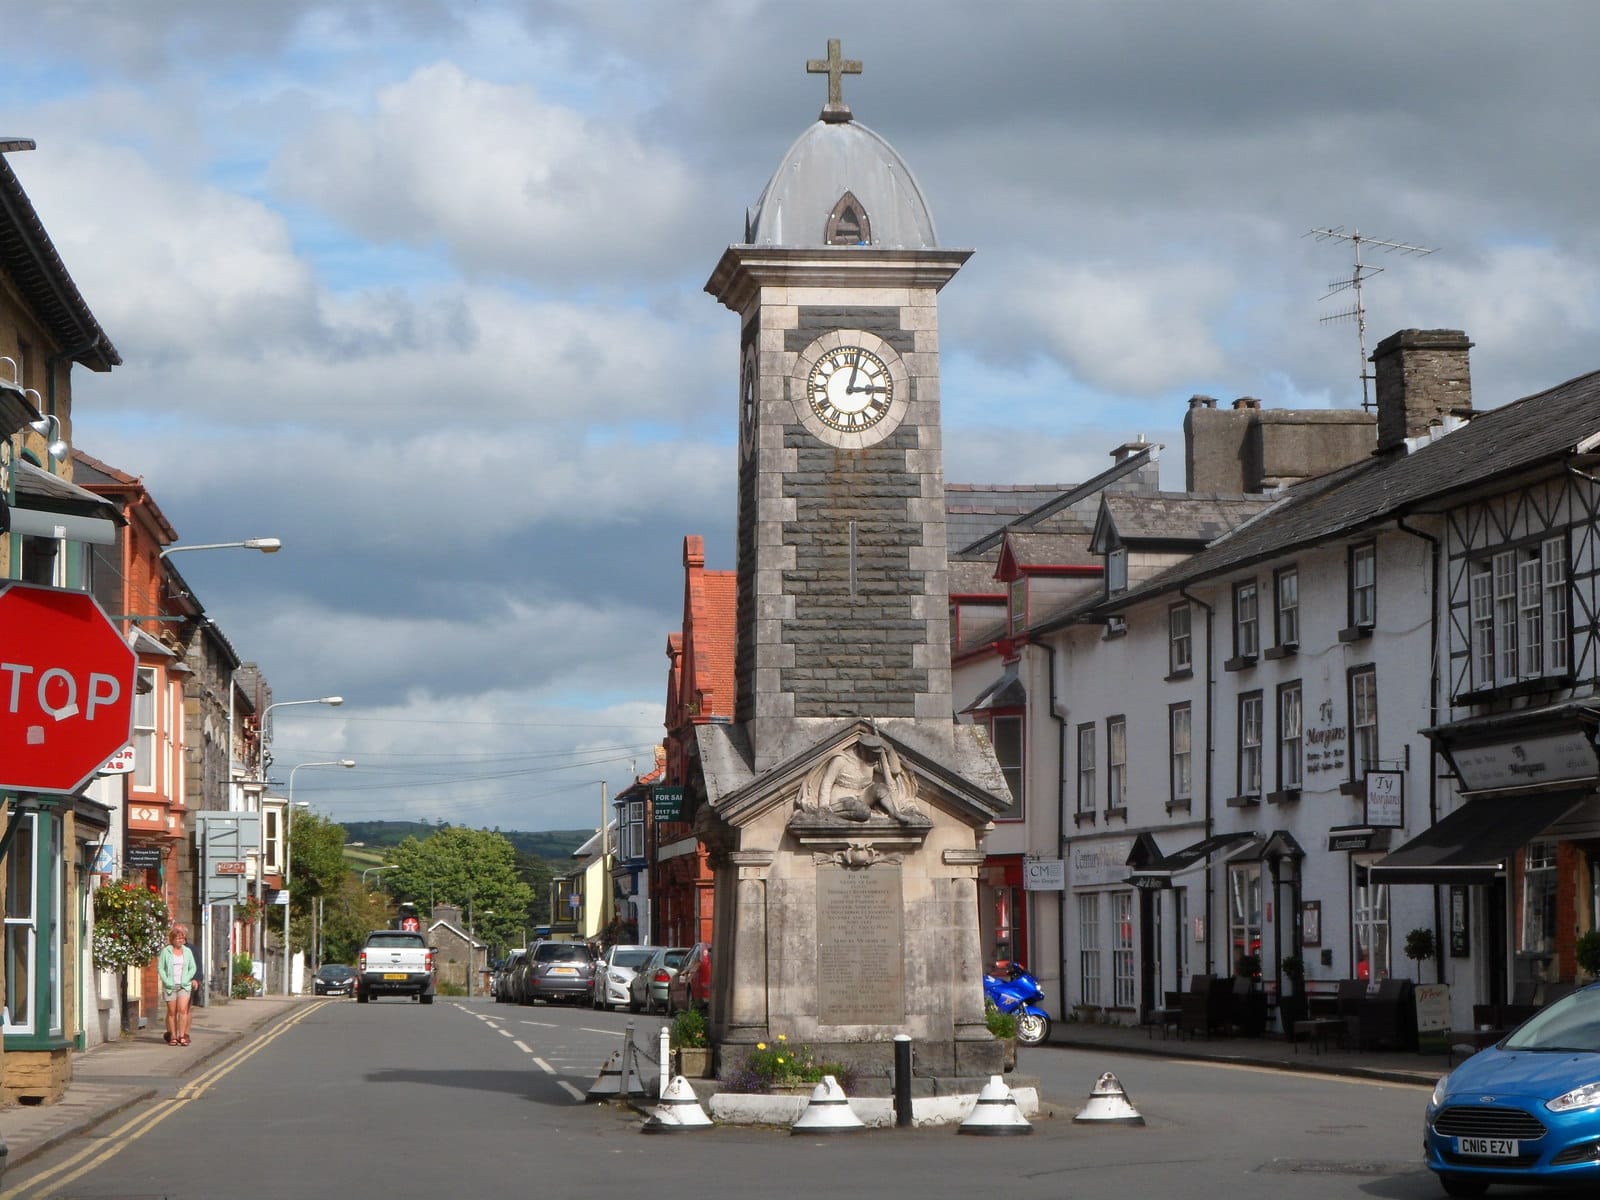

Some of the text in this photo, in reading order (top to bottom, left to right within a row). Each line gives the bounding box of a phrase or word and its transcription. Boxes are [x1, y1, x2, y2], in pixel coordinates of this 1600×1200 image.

[0, 662, 121, 721] TOP
[1305, 726, 1347, 749] Morgans
[1375, 776, 1393, 794] Ty
[1368, 791, 1401, 810] Morgans
[1462, 1139, 1513, 1154] CN16 EZV
